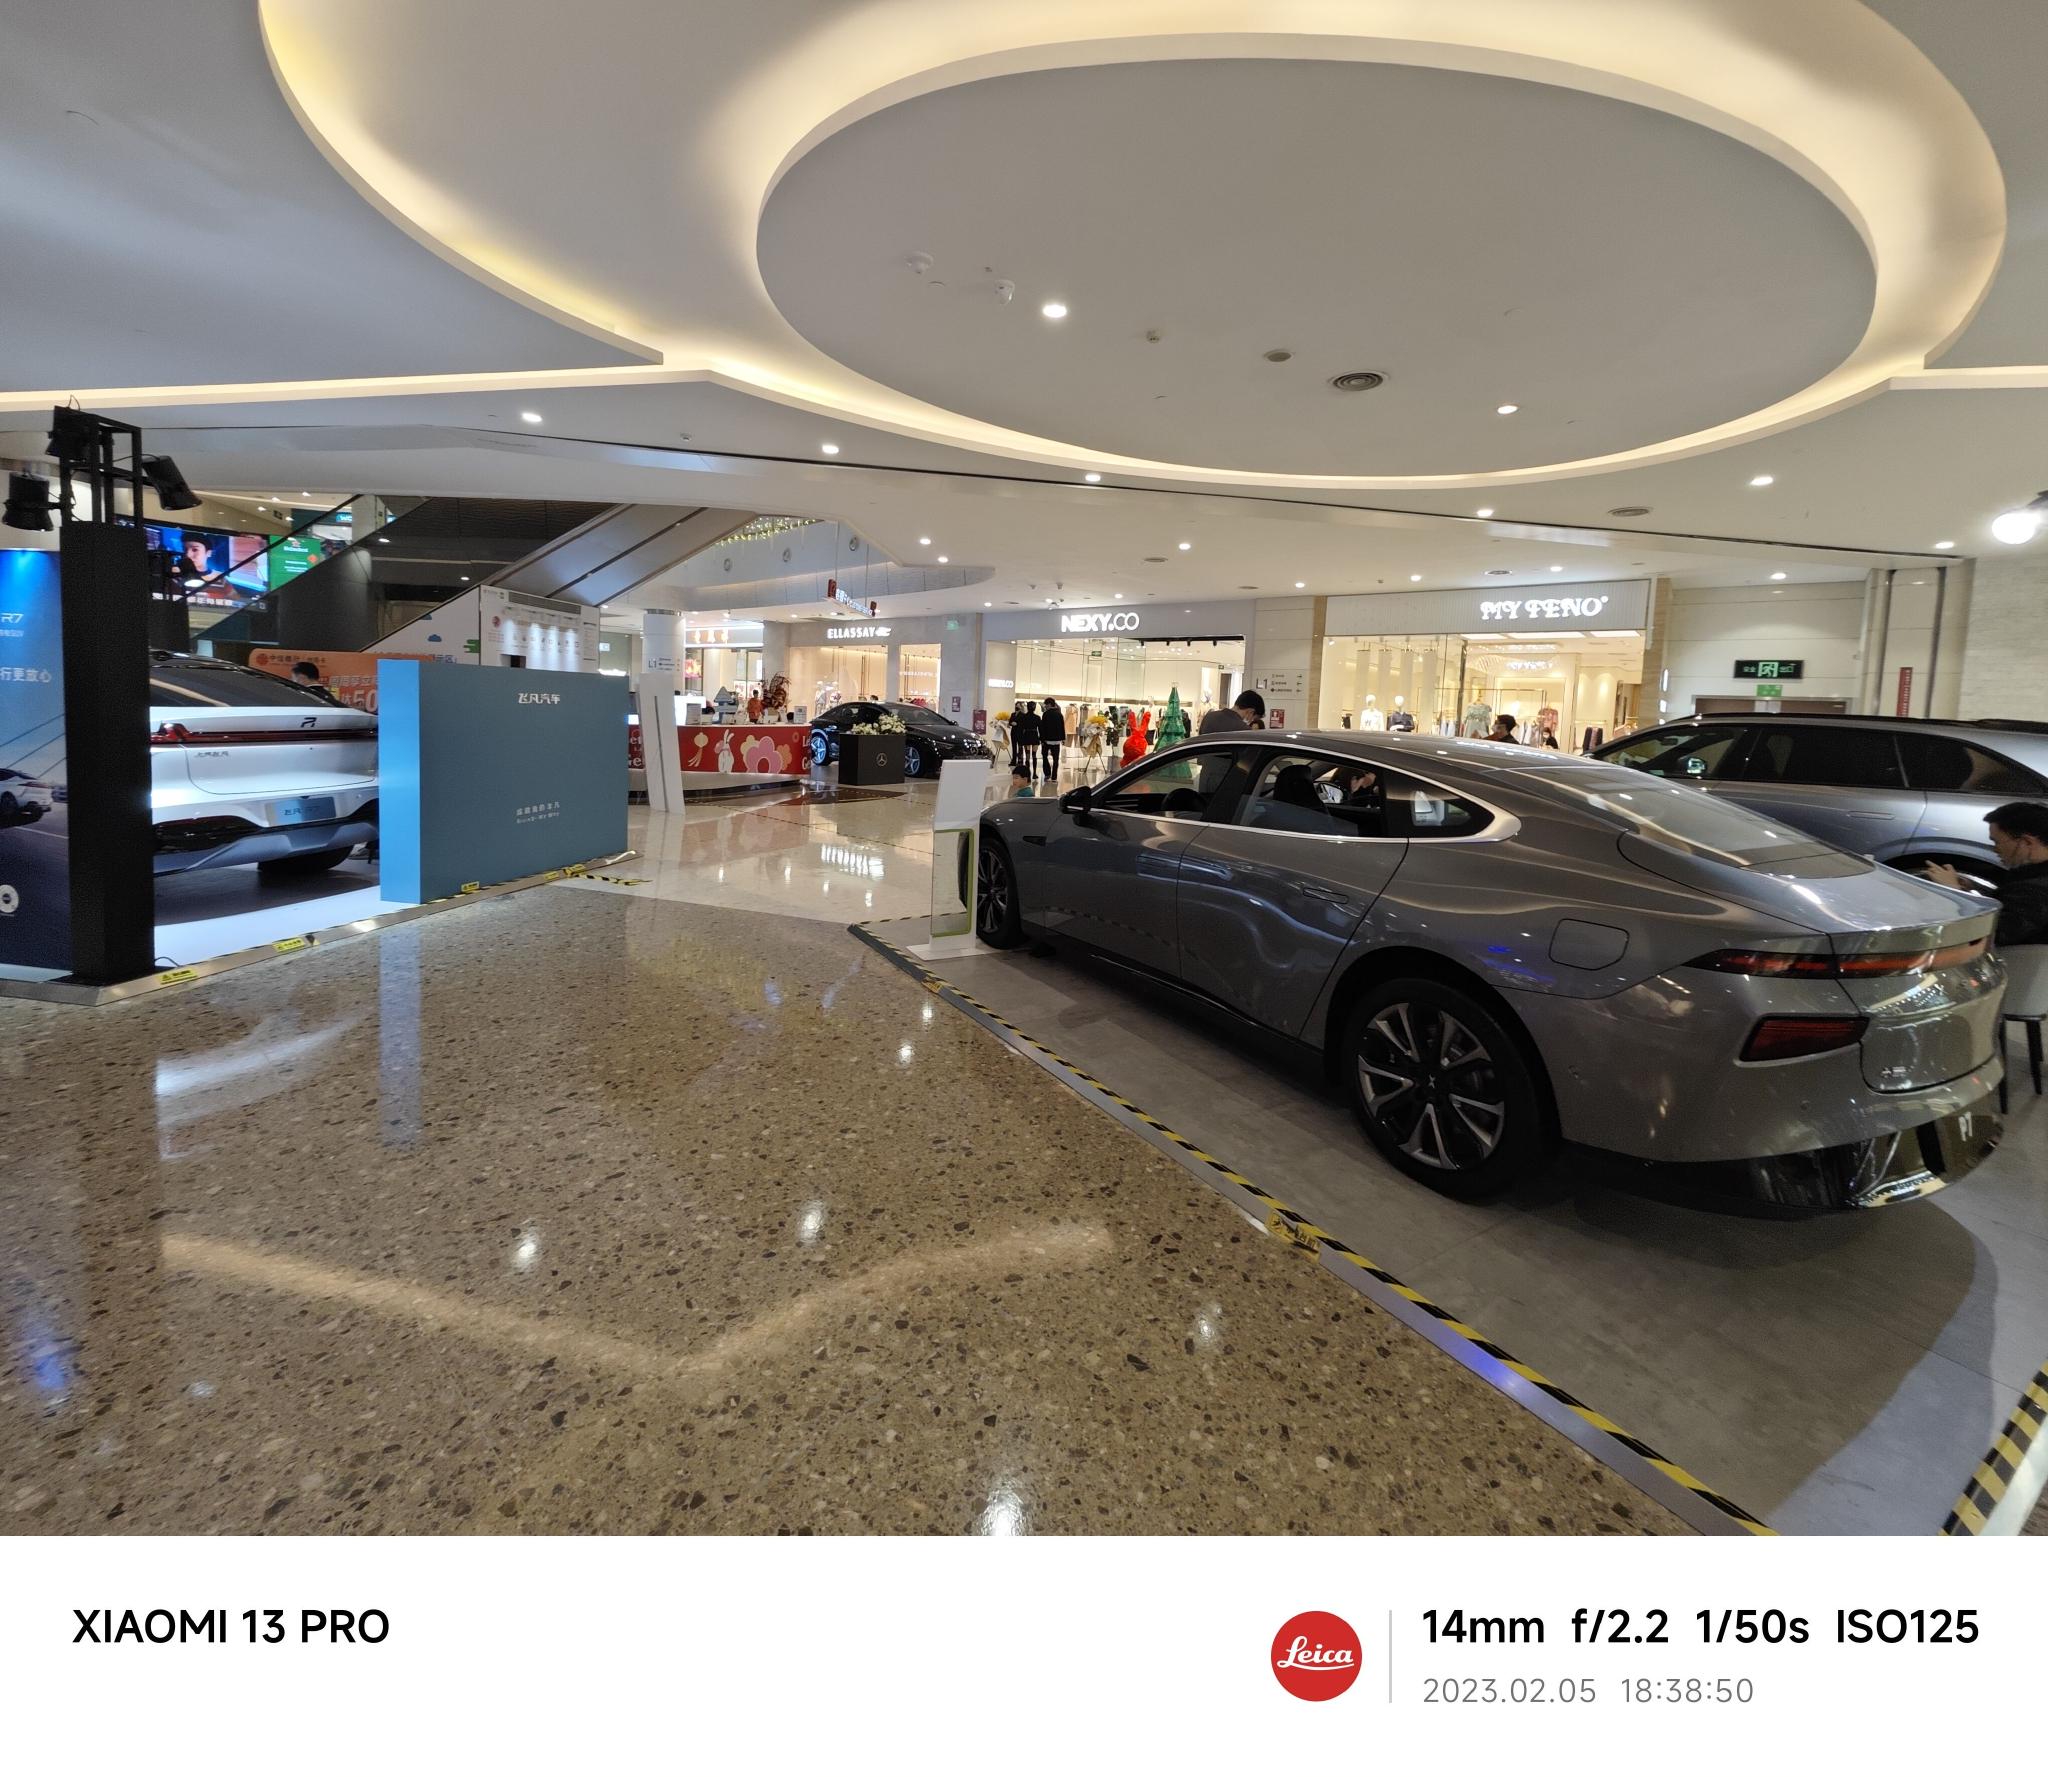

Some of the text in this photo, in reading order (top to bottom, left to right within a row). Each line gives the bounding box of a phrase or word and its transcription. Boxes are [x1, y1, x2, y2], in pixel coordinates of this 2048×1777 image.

[1480, 601, 1522, 620] MY
[1061, 612, 1140, 633] NEXY.CO
[827, 627, 876, 639] ELLASSAY
